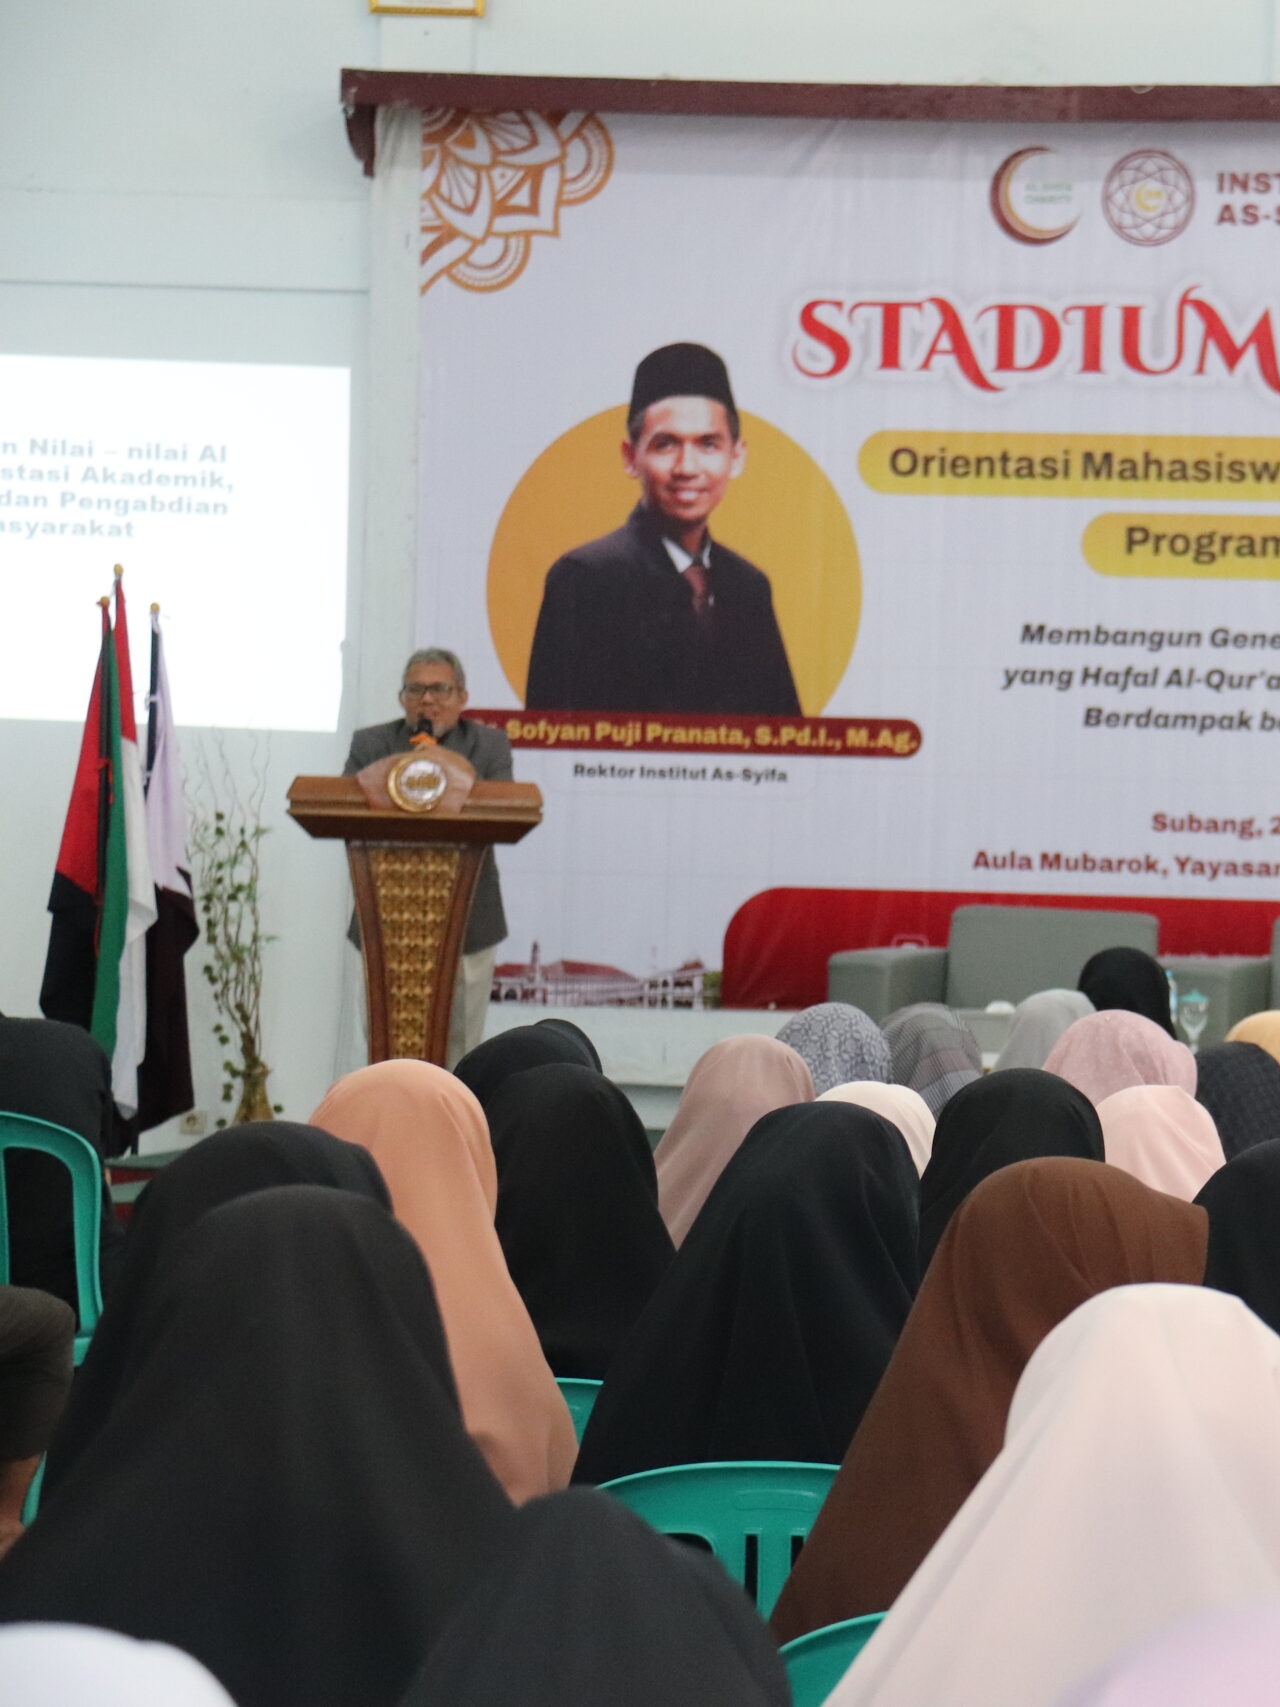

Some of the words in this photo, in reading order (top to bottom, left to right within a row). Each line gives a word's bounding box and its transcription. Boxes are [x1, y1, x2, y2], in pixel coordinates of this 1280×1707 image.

[29, 438, 94, 458] Nilai
[127, 443, 188, 462] nilai
[889, 447, 1072, 480] Orientasi
[81, 466, 234, 493] Akademik,
[59, 491, 228, 516] Pengabdian
[1020, 624, 1201, 652] Membangun
[1002, 667, 1073, 691] yang
[1081, 667, 1158, 692] Hafal
[1083, 707, 1253, 735] Berdampak
[505, 719, 591, 745] Sofyan
[595, 721, 642, 747] Puji
[646, 722, 751, 749] Pranata,
[846, 728, 918, 754] M.Ag.
[573, 763, 635, 779] Rektor
[639, 765, 707, 781] Institut
[712, 767, 788, 786] As-Syifa
[1151, 812, 1263, 840] Subang,
[973, 850, 1033, 870] Aula
[1040, 852, 1168, 877] Mubarok,
